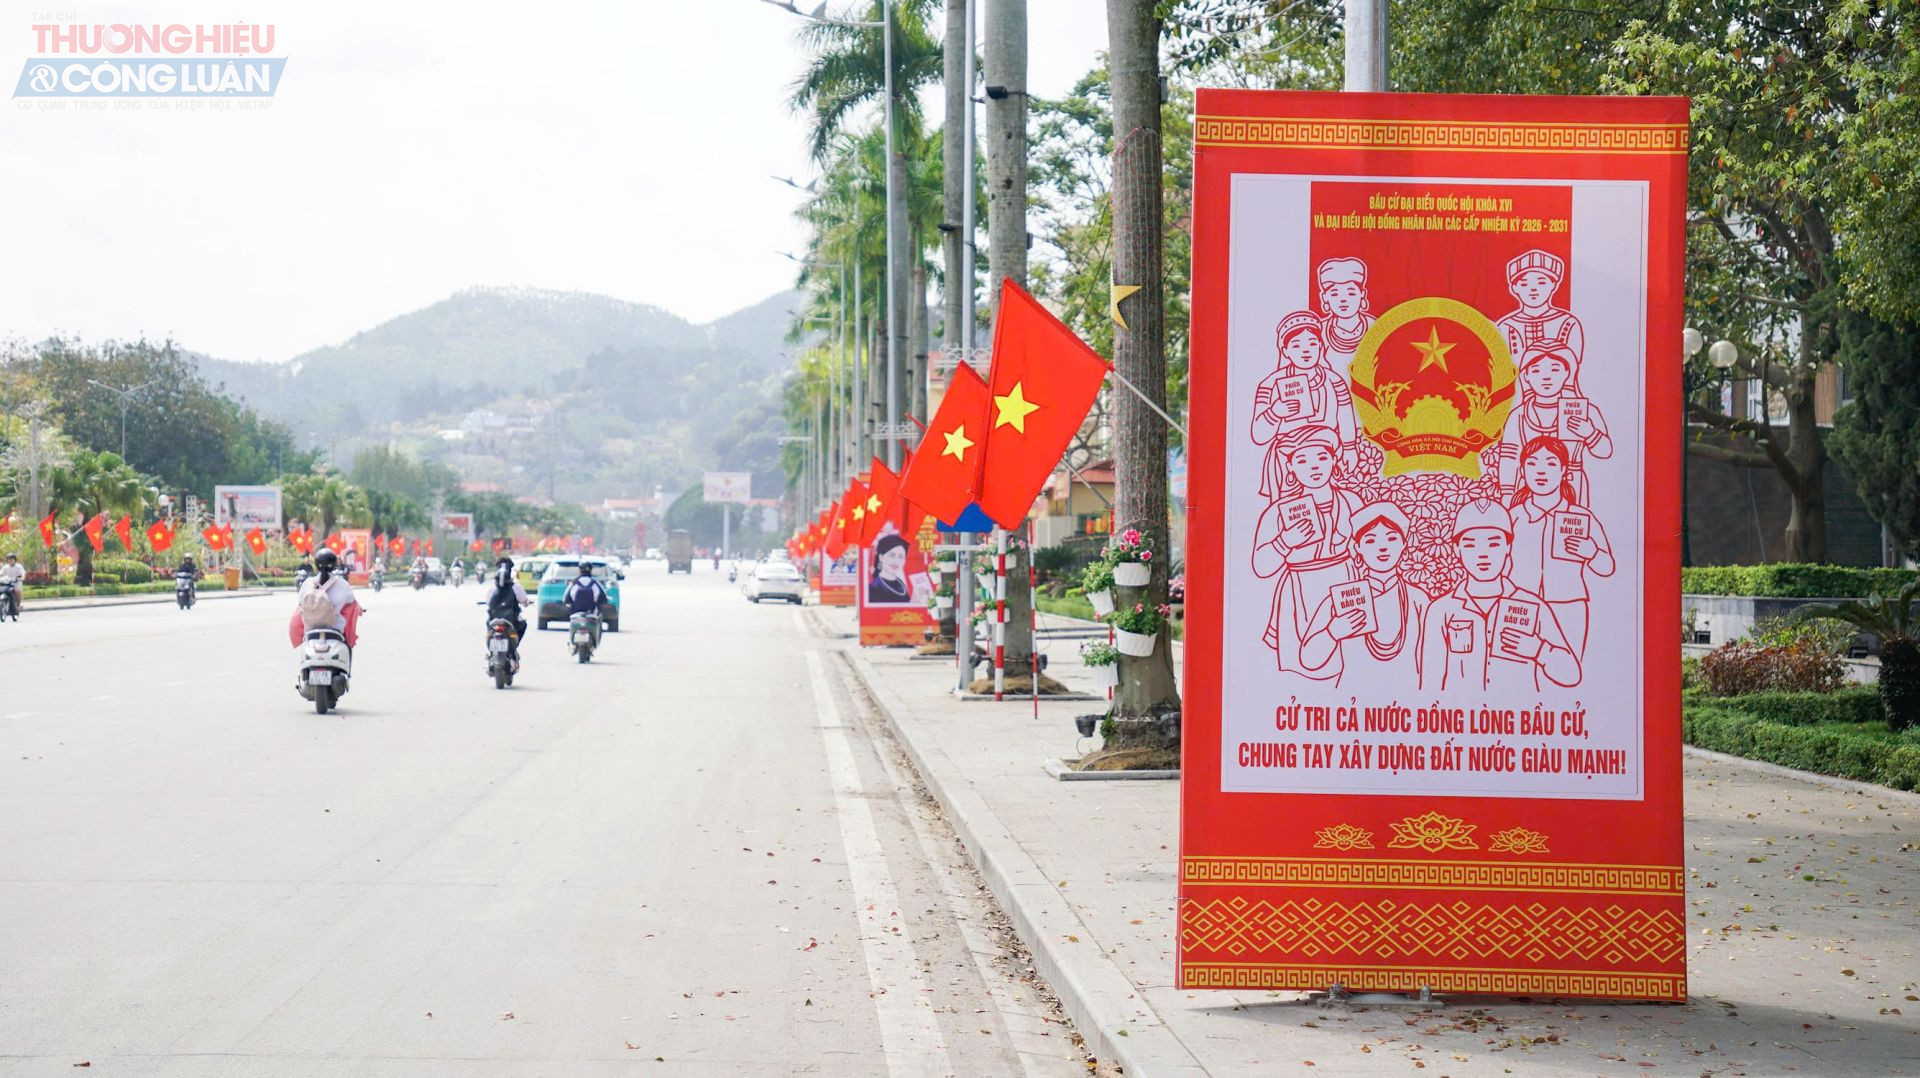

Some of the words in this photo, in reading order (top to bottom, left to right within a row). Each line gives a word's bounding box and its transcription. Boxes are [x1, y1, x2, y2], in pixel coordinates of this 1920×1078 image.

[1400, 196, 1414, 213] ĐẠI
[1437, 193, 1458, 212] QUỐC
[1460, 195, 1474, 214] HỘI
[1475, 195, 1497, 212] KHÓA
[1499, 198, 1513, 212] XVI
[1314, 212, 1325, 228] VÀ
[1326, 215, 1340, 231] ĐẠI
[1362, 213, 1376, 232] HỘI
[1402, 214, 1424, 230] NHÂN
[1426, 214, 1443, 230] DÂN
[1445, 214, 1461, 231] CÁC
[1463, 213, 1480, 231] CẤP
[1481, 215, 1508, 234] NHIỆM
[1522, 219, 1542, 232] 2026
[1549, 219, 1568, 233] 2031
[1434, 443, 1457, 453] NAM
[1276, 695, 1301, 731] CỬ
[1304, 706, 1330, 731] TRI
[1336, 696, 1359, 732] CẢ
[1364, 700, 1411, 732] NƯỚC
[1417, 700, 1464, 733] ĐỒNG
[1470, 703, 1514, 735] LÒNG
[1520, 702, 1555, 735] BẦU
[1560, 700, 1589, 740] CỬ,
[1238, 742, 1297, 768] CHUNG
[1302, 743, 1334, 769] TAY
[1339, 739, 1373, 769] XÂY
[1378, 742, 1425, 775] DỰNG
[1430, 737, 1463, 771] ĐẤT
[1468, 740, 1516, 772] NƯỚC
[1521, 743, 1562, 774] GIÀU
[1567, 749, 1626, 780] MẠNH!
